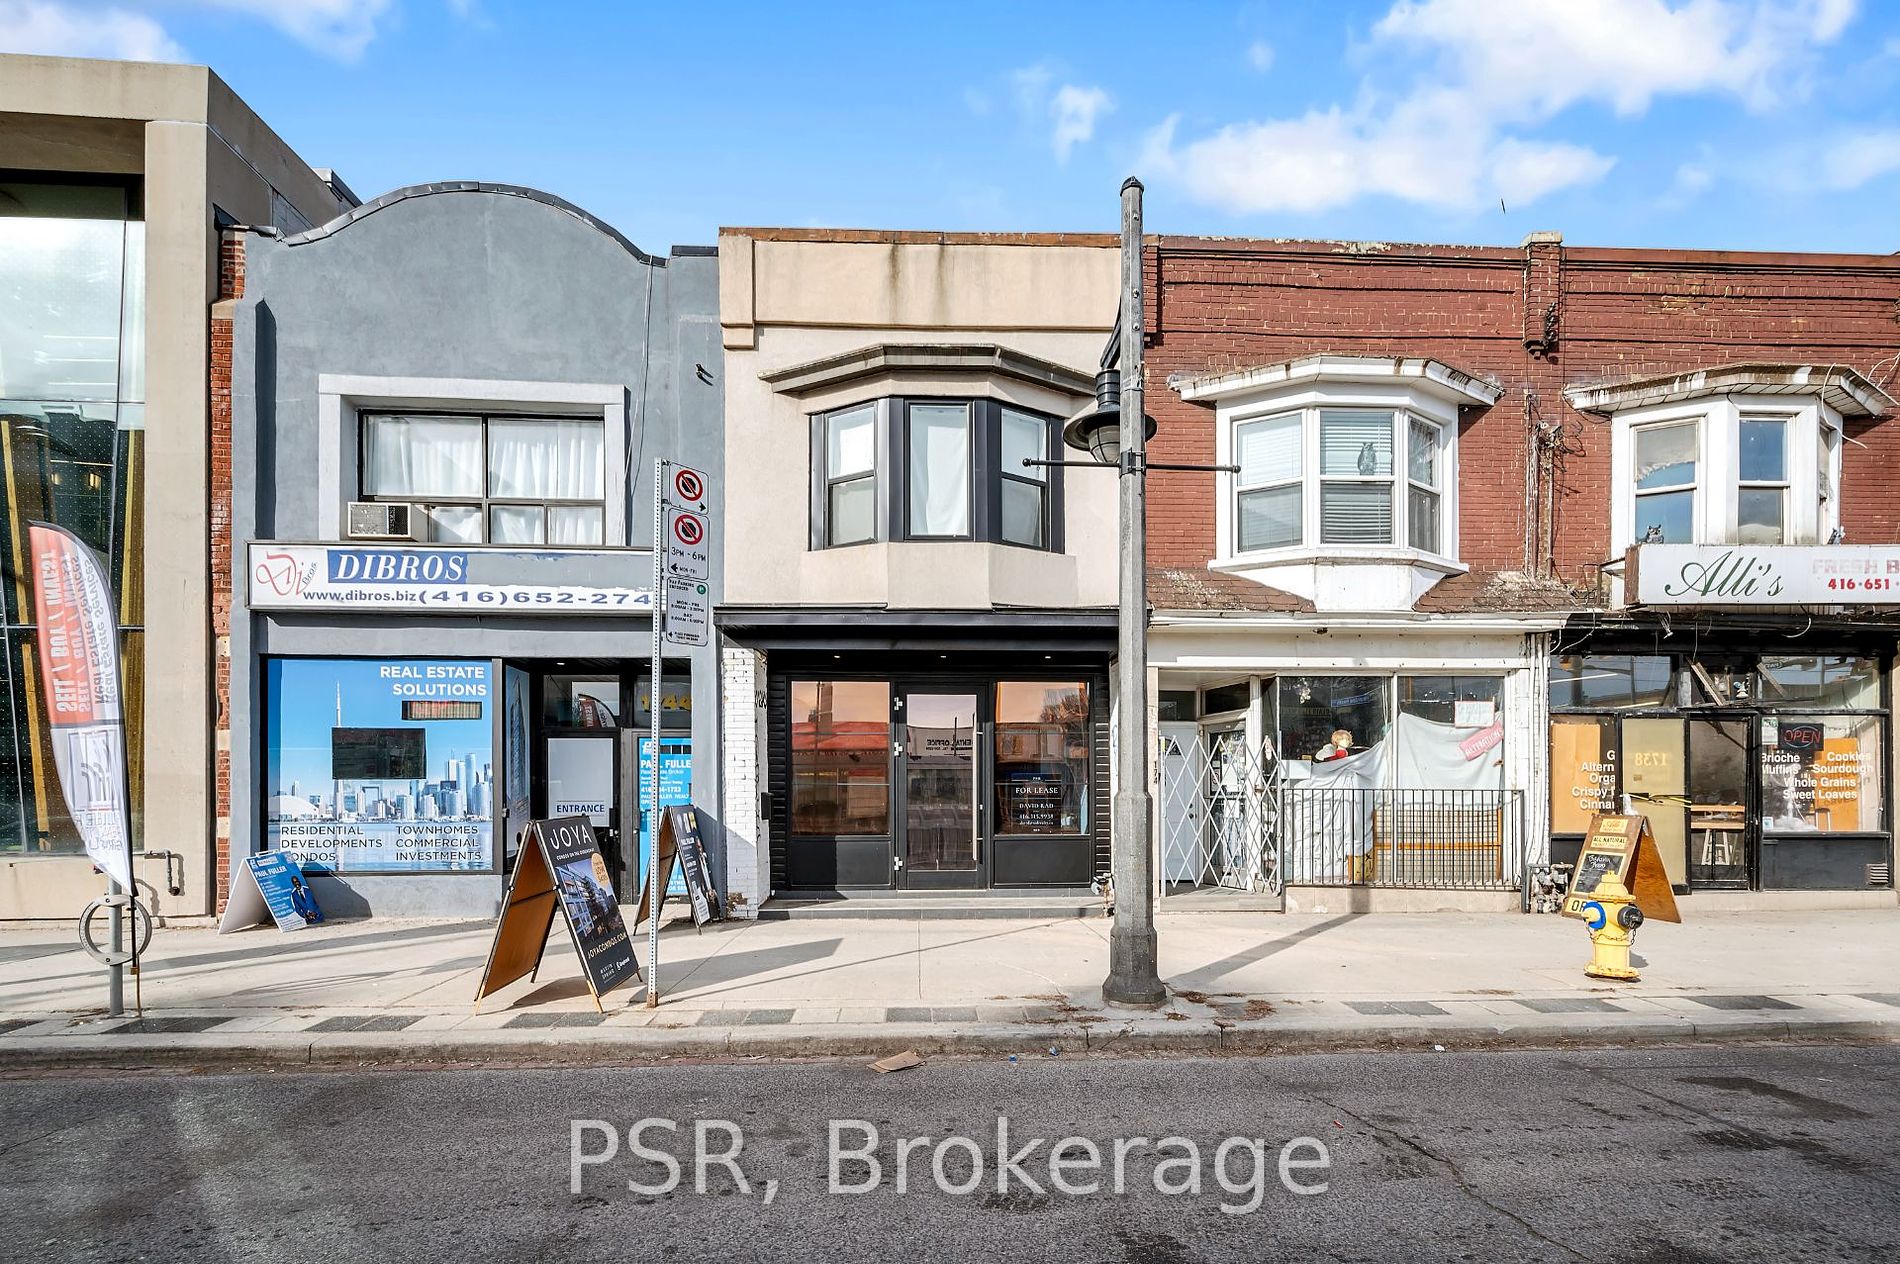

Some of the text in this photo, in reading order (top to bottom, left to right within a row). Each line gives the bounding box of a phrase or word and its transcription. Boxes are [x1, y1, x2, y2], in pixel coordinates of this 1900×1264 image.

[333, 554, 465, 581] DIBROS
[1812, 559, 1900, 574] FRESH B
[1664, 550, 1784, 597] Alli's
[303, 589, 655, 606] www.dibros.biz (416)652-274
[380, 666, 485, 679] REAL ESTATE
[392, 683, 487, 696] SOLUTIONS
[1783, 730, 1822, 744] OPEN
[1827, 751, 1871, 762] Cookies
[641, 760, 663, 768] PAL
[1813, 764, 1874, 777] Sourdough
[1784, 777, 1857, 787] Whole Grains
[1572, 787, 1608, 798] Crispy
[1783, 789, 1858, 800] Sweet Loaves
[556, 804, 605, 813] ENTRANCE
[281, 826, 478, 836] RESIDENTIAL TOWNHOMES
[550, 824, 592, 850] JOYA
[1602, 836, 1626, 844] NATURAL
[281, 838, 479, 848] DEVELOPMENTS COMMERCIAL
[290, 851, 482, 861] ONDOS INVESTMENTS
